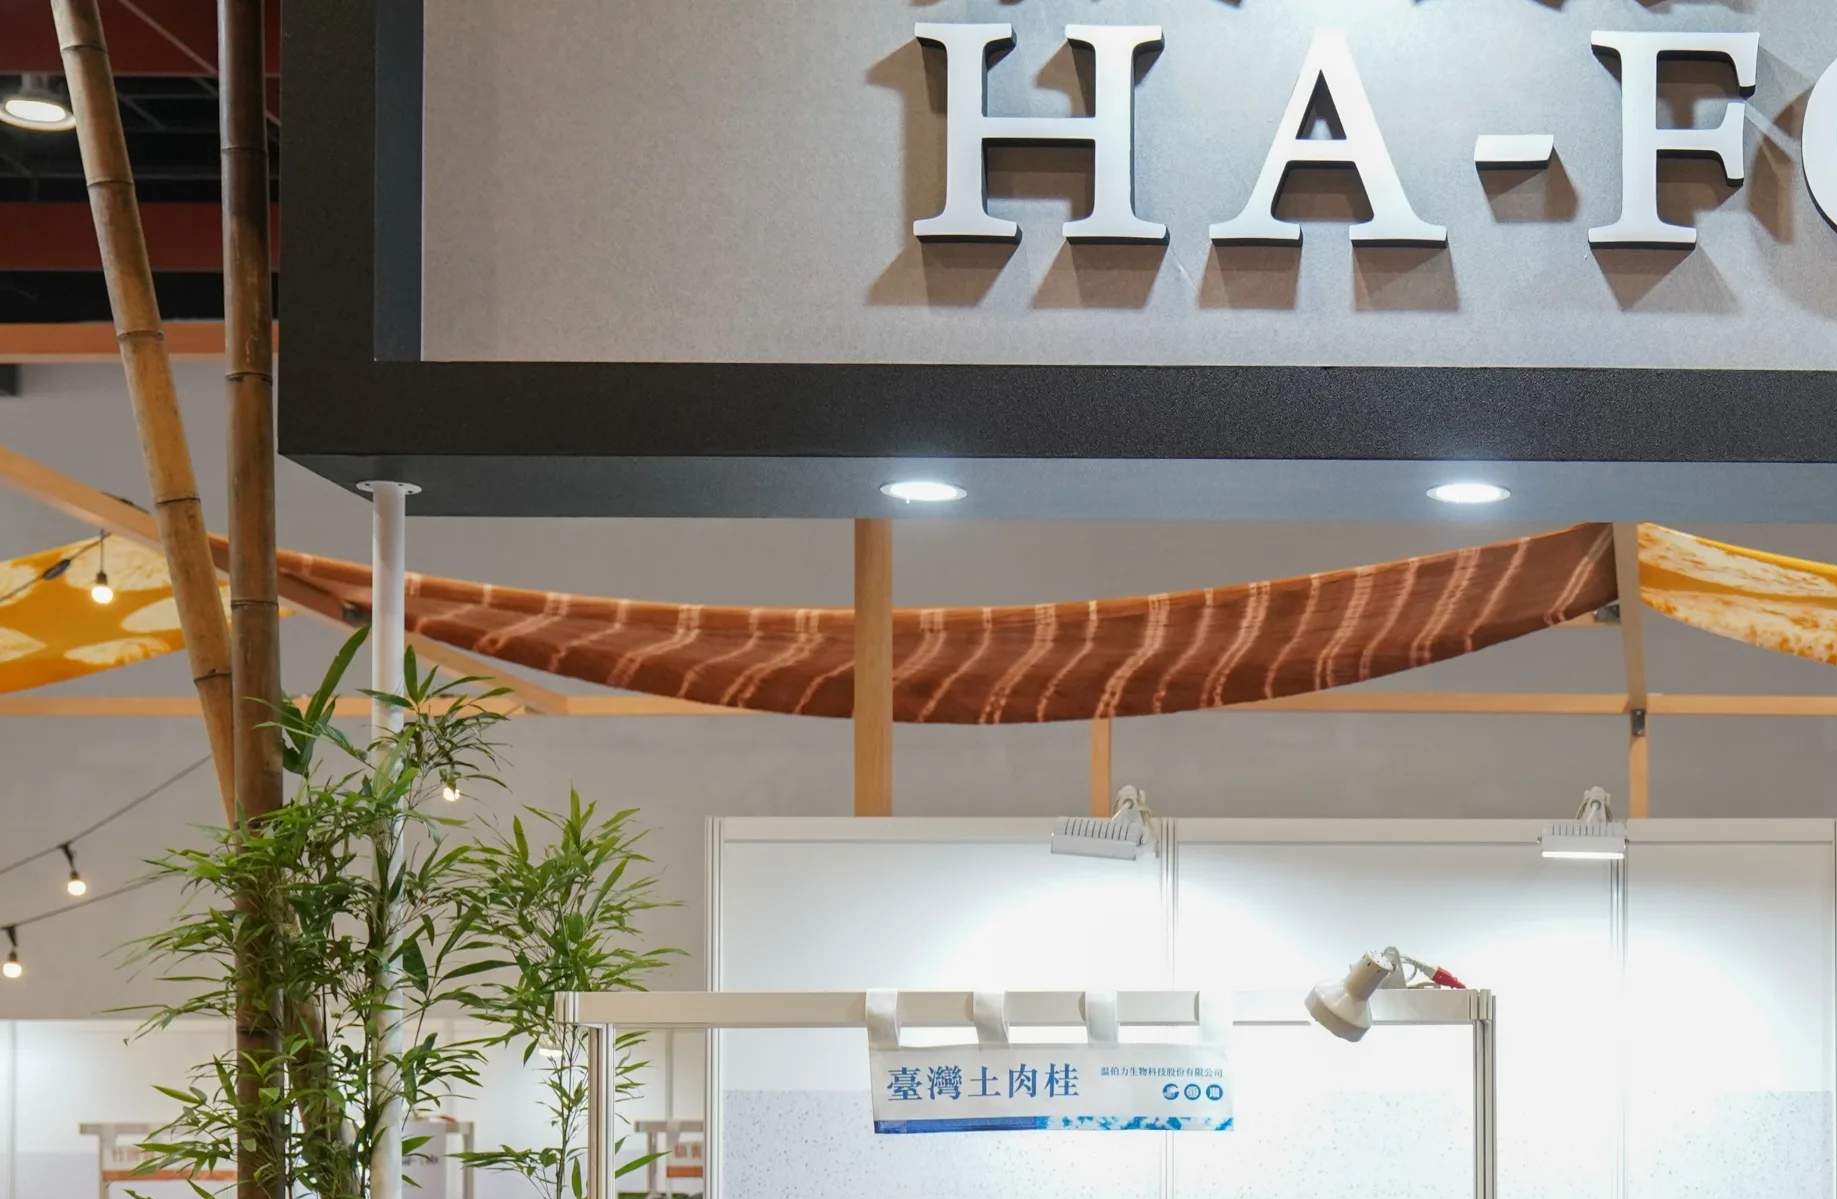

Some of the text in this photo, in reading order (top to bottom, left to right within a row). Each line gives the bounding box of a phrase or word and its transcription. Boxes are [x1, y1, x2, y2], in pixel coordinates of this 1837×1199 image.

[886, 1063, 1080, 1101] 臺灣土肉桂
